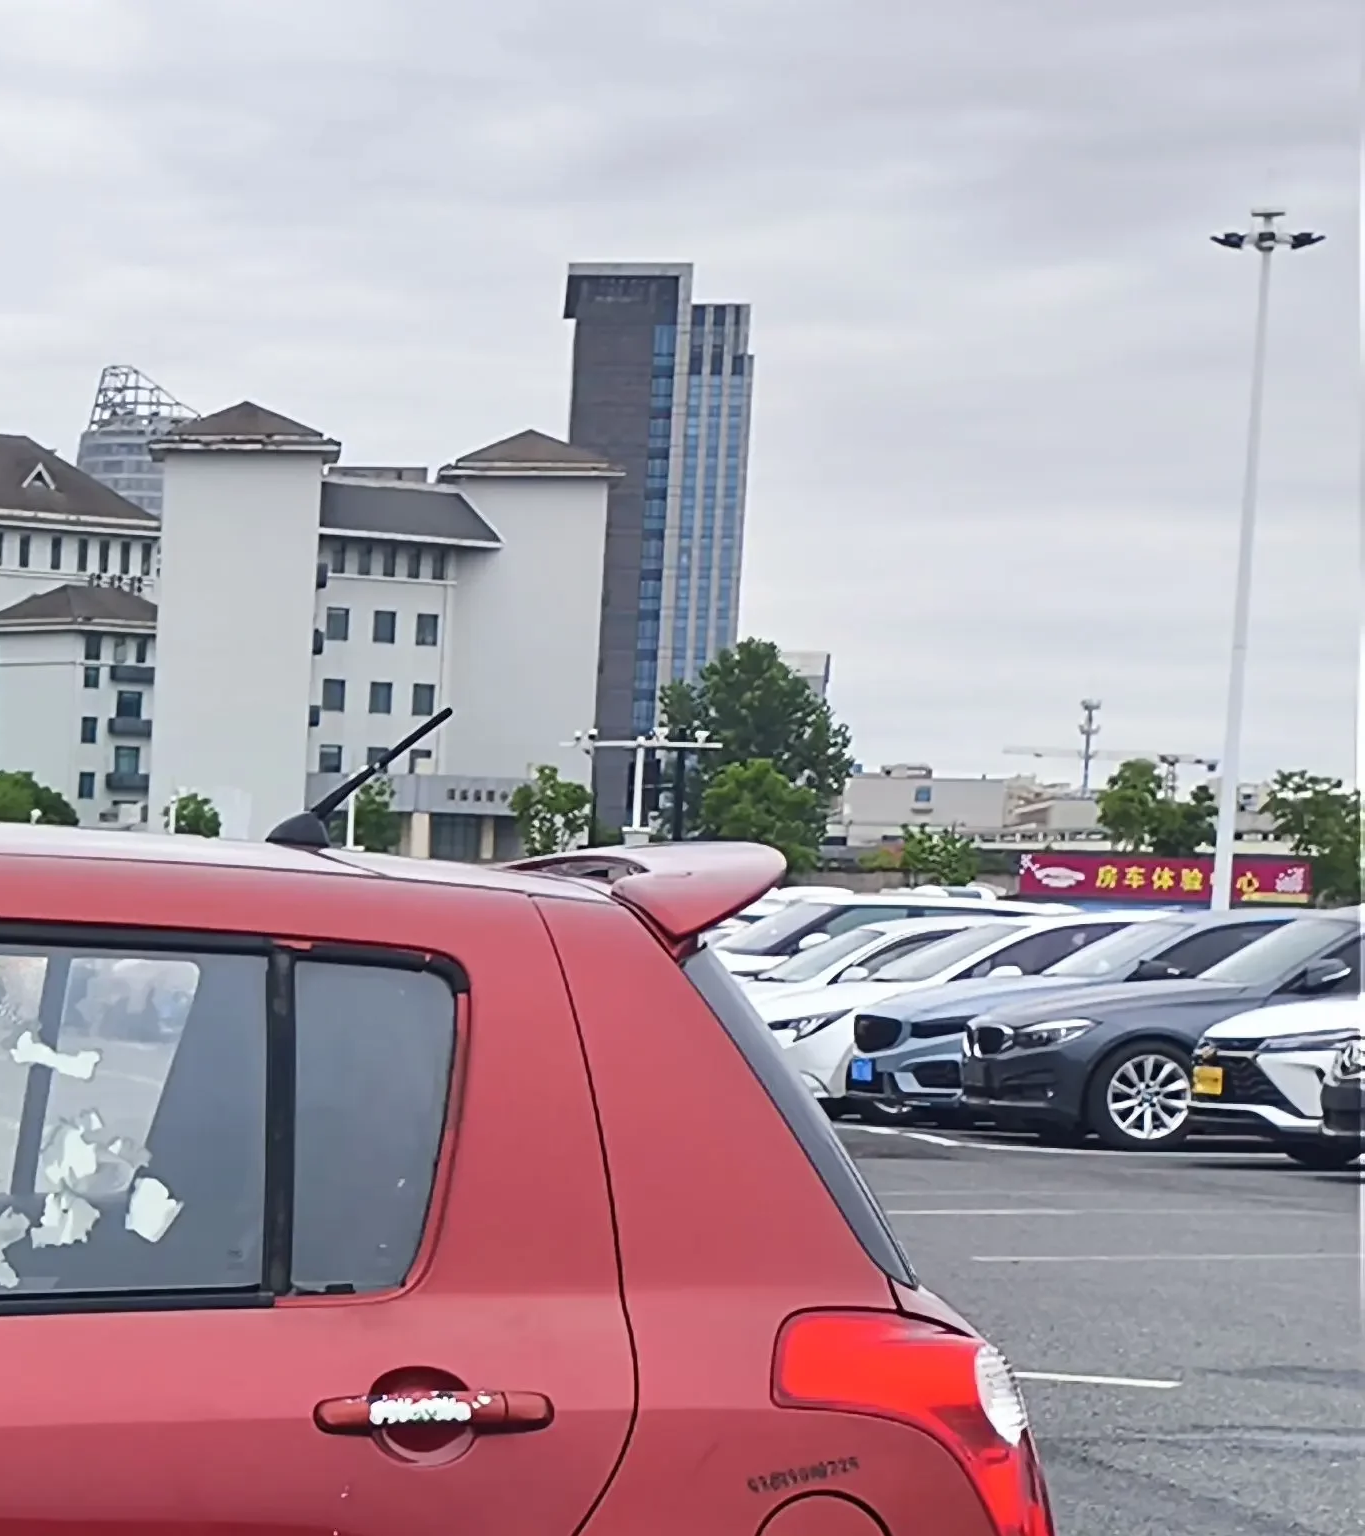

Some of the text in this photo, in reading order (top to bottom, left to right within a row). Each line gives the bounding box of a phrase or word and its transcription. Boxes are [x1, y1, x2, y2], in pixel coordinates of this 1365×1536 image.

[1095, 864, 1260, 895] 房车体验心
